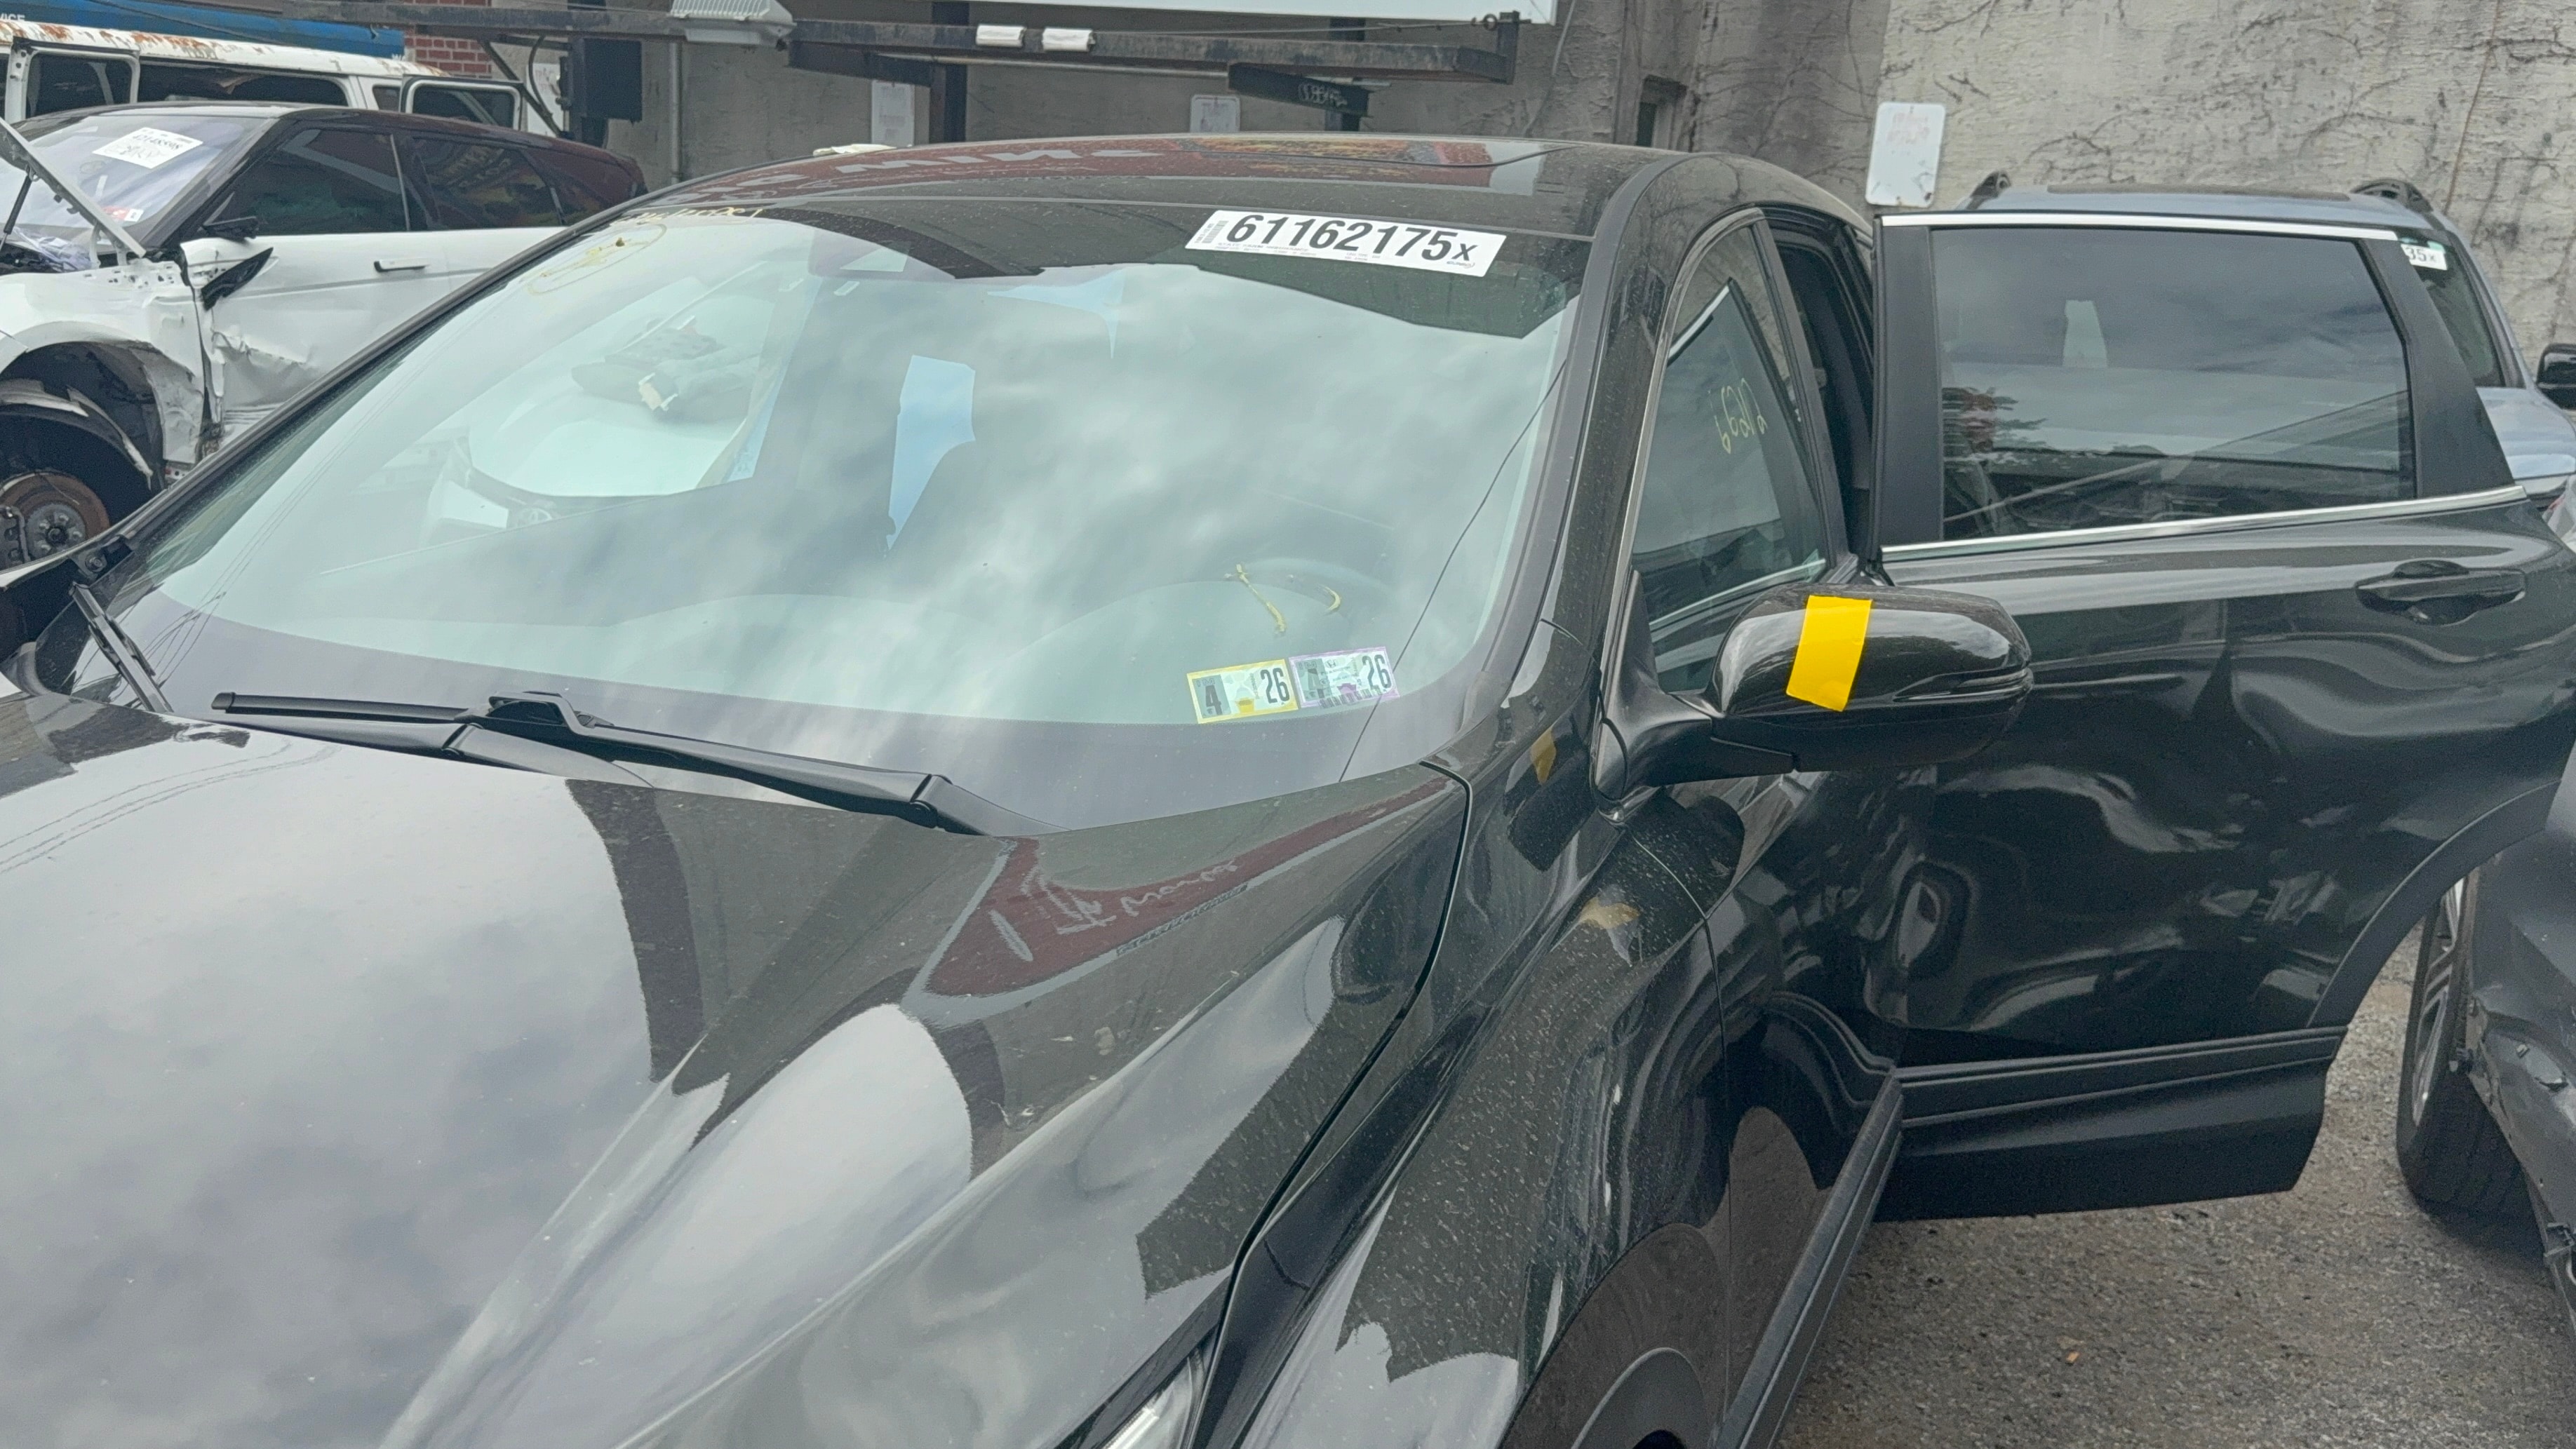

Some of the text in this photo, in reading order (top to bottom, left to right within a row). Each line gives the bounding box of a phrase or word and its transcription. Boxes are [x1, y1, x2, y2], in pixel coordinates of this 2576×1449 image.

[1205, 685, 1223, 716] 4
[1260, 667, 1290, 704] 26
[1362, 654, 1392, 690] 26
